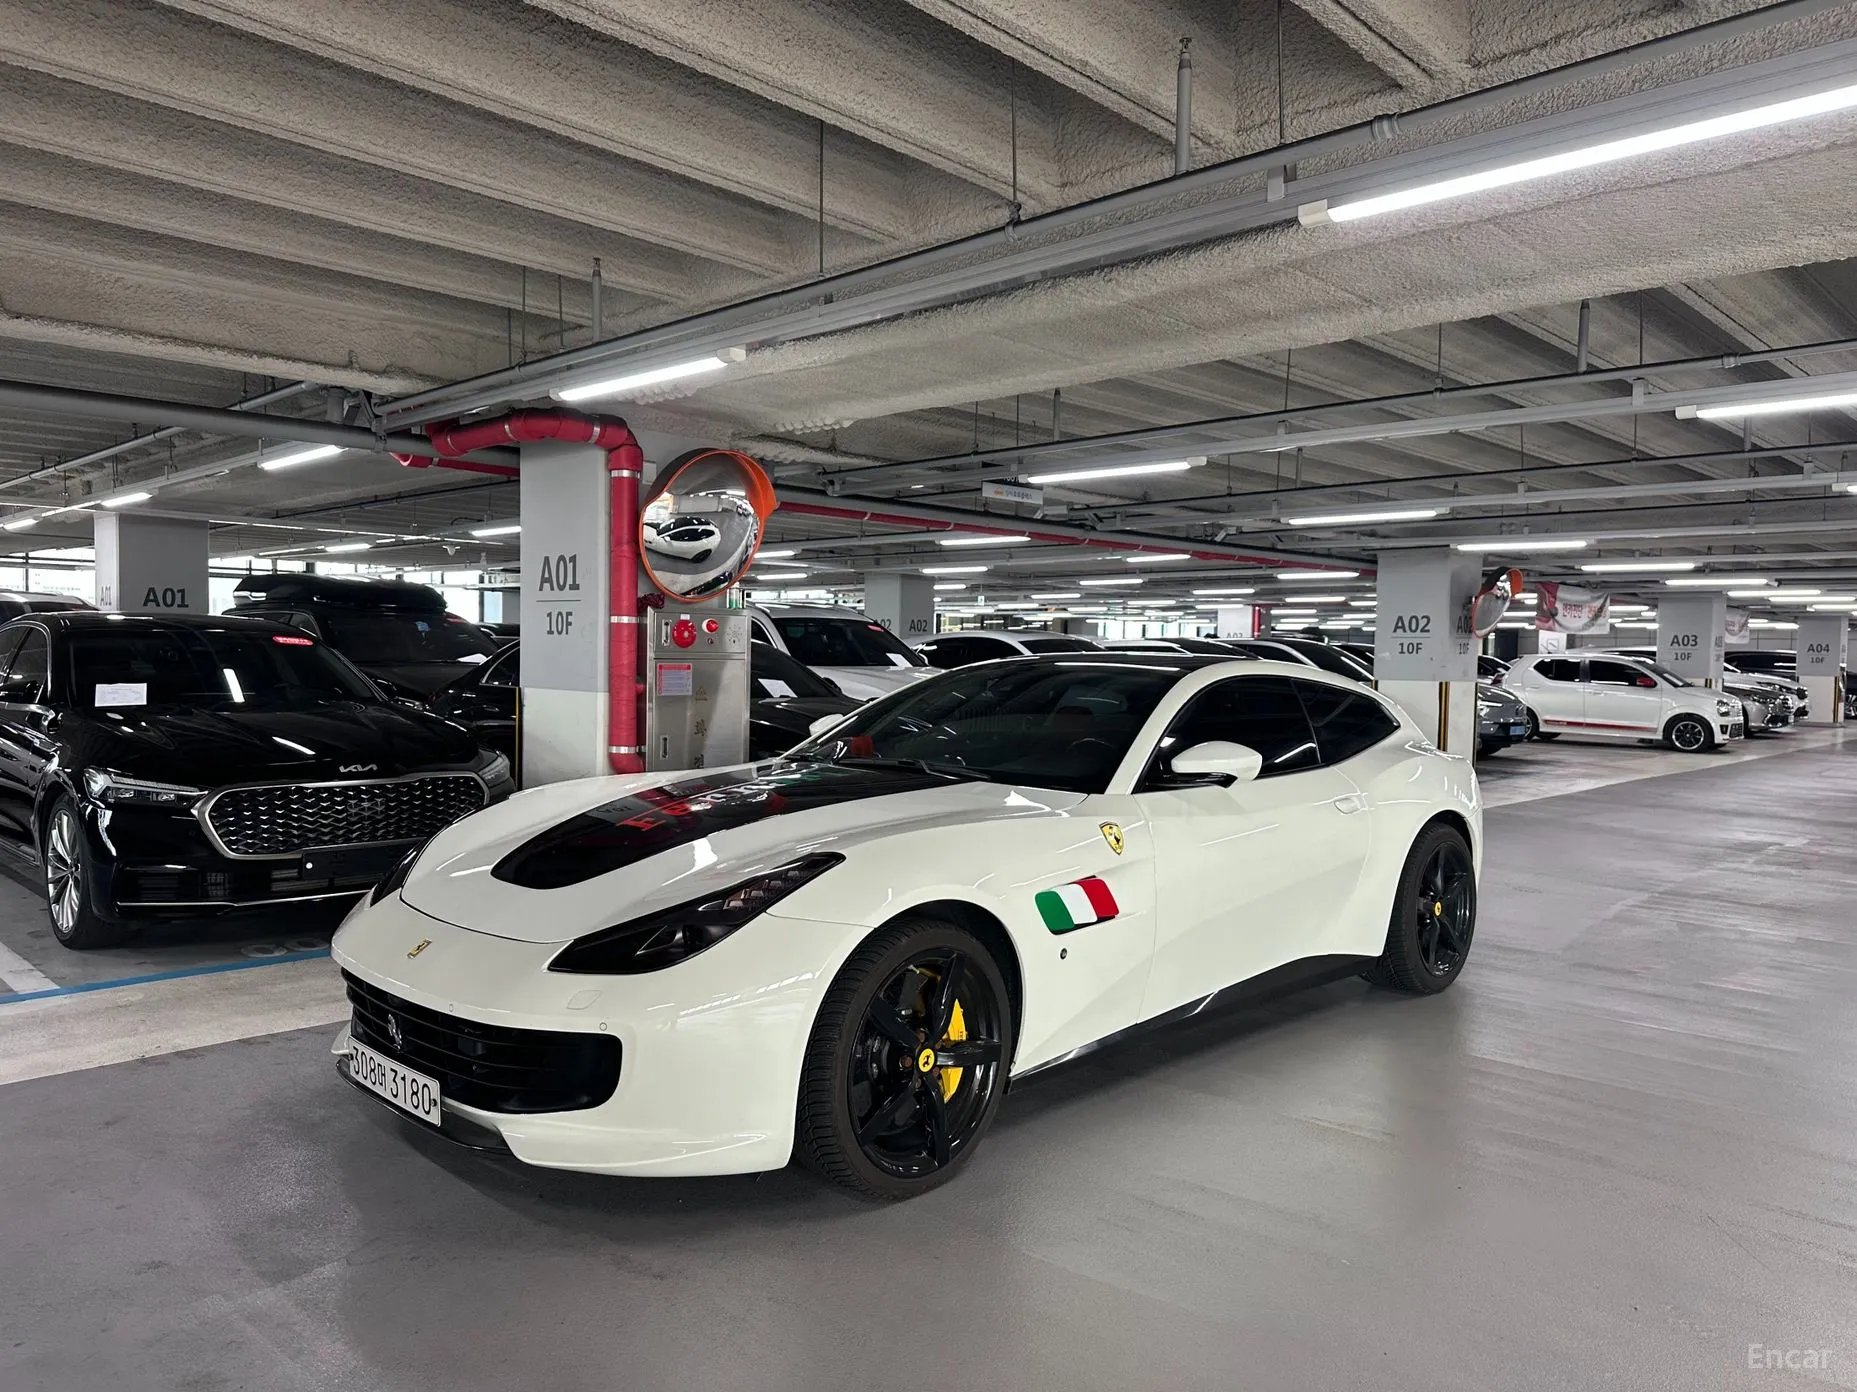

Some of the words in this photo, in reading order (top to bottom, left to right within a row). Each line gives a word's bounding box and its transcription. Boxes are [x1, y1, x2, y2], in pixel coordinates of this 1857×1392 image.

[538, 554, 580, 591] A01
[142, 587, 189, 608] A01
[546, 611, 573, 635] 10F
[909, 619, 928, 632] A02
[1392, 615, 1431, 633] A02
[1670, 635, 1698, 647] A03
[1398, 642, 1422, 654] 10F
[1807, 643, 1830, 653] A04
[1674, 652, 1692, 661] 10F
[1810, 656, 1825, 664] 10F
[353, 1046, 387, 1092] 308머
[389, 1067, 431, 1115] 3180
